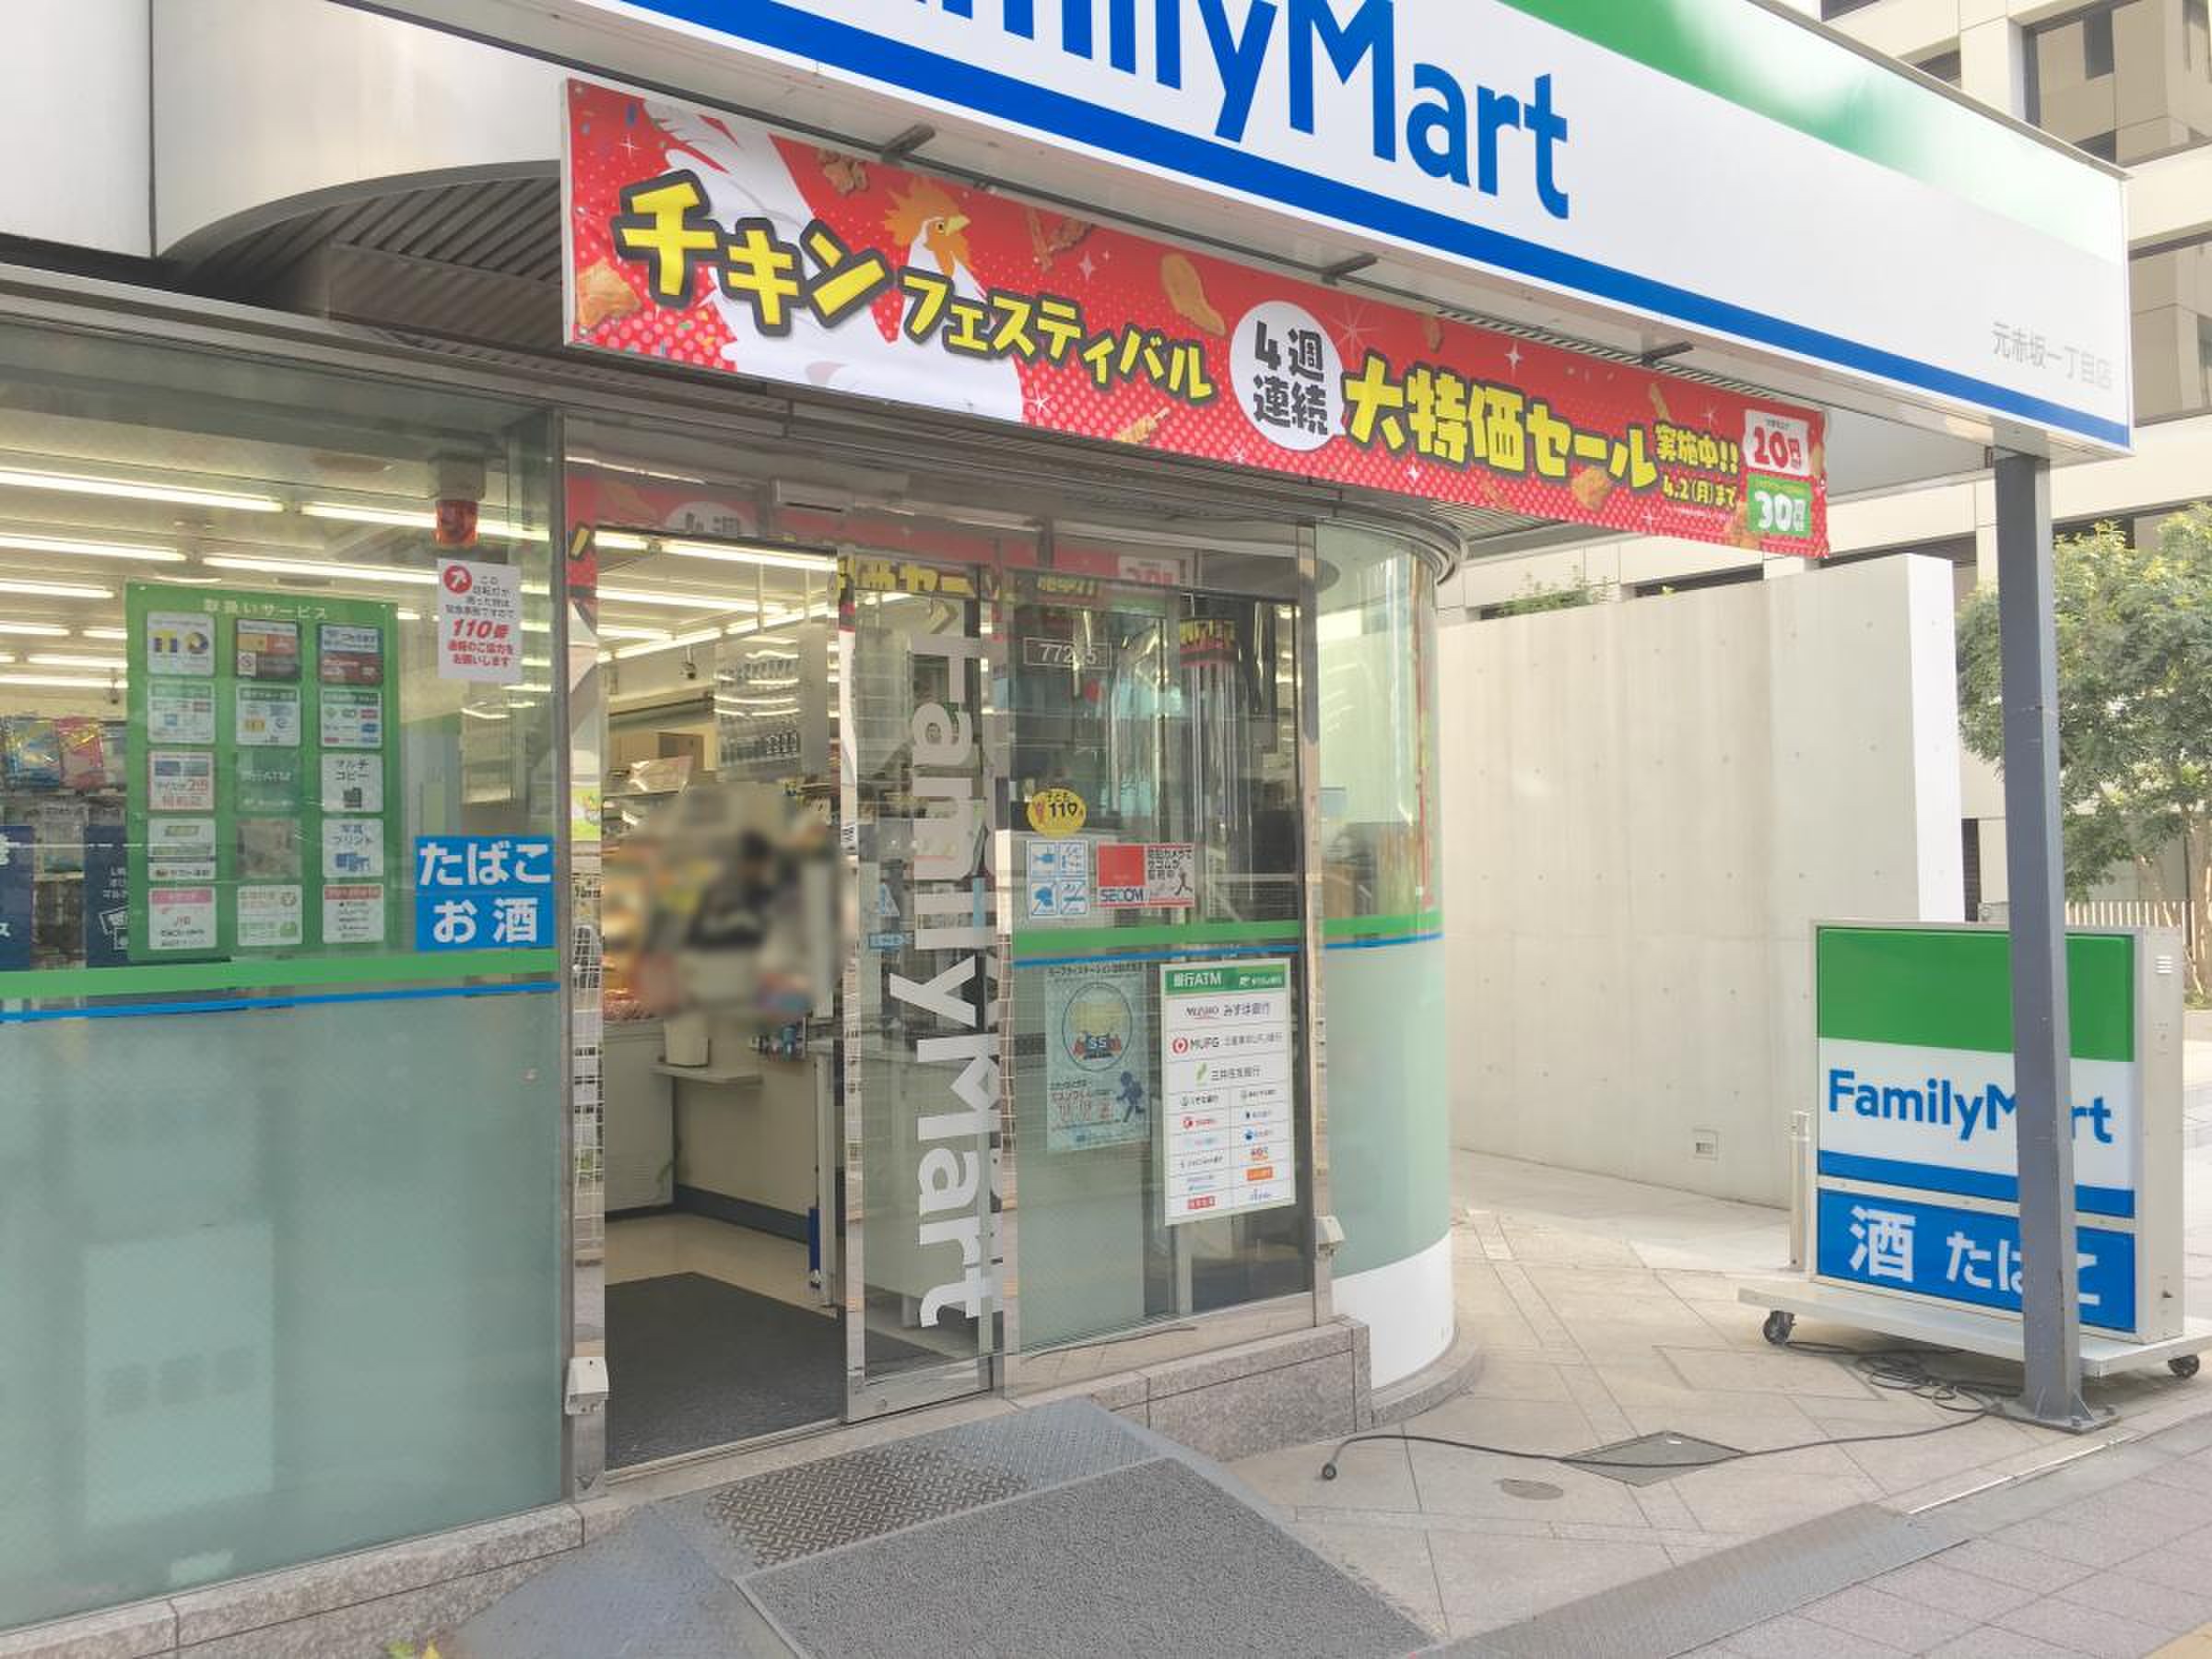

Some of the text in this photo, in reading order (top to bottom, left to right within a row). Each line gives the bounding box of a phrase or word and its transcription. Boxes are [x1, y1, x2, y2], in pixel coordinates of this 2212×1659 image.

[1253, 319, 1325, 383] 4週
[1252, 374, 1329, 436] 連続
[1343, 354, 1659, 489] 大特価セール
[419, 840, 552, 887] たばこ
[1100, 888, 1145, 902] SECOM
[432, 897, 540, 944] お酒
[1828, 1068, 2113, 1144] FamilyMrt
[1849, 1204, 1917, 1283] 酒
